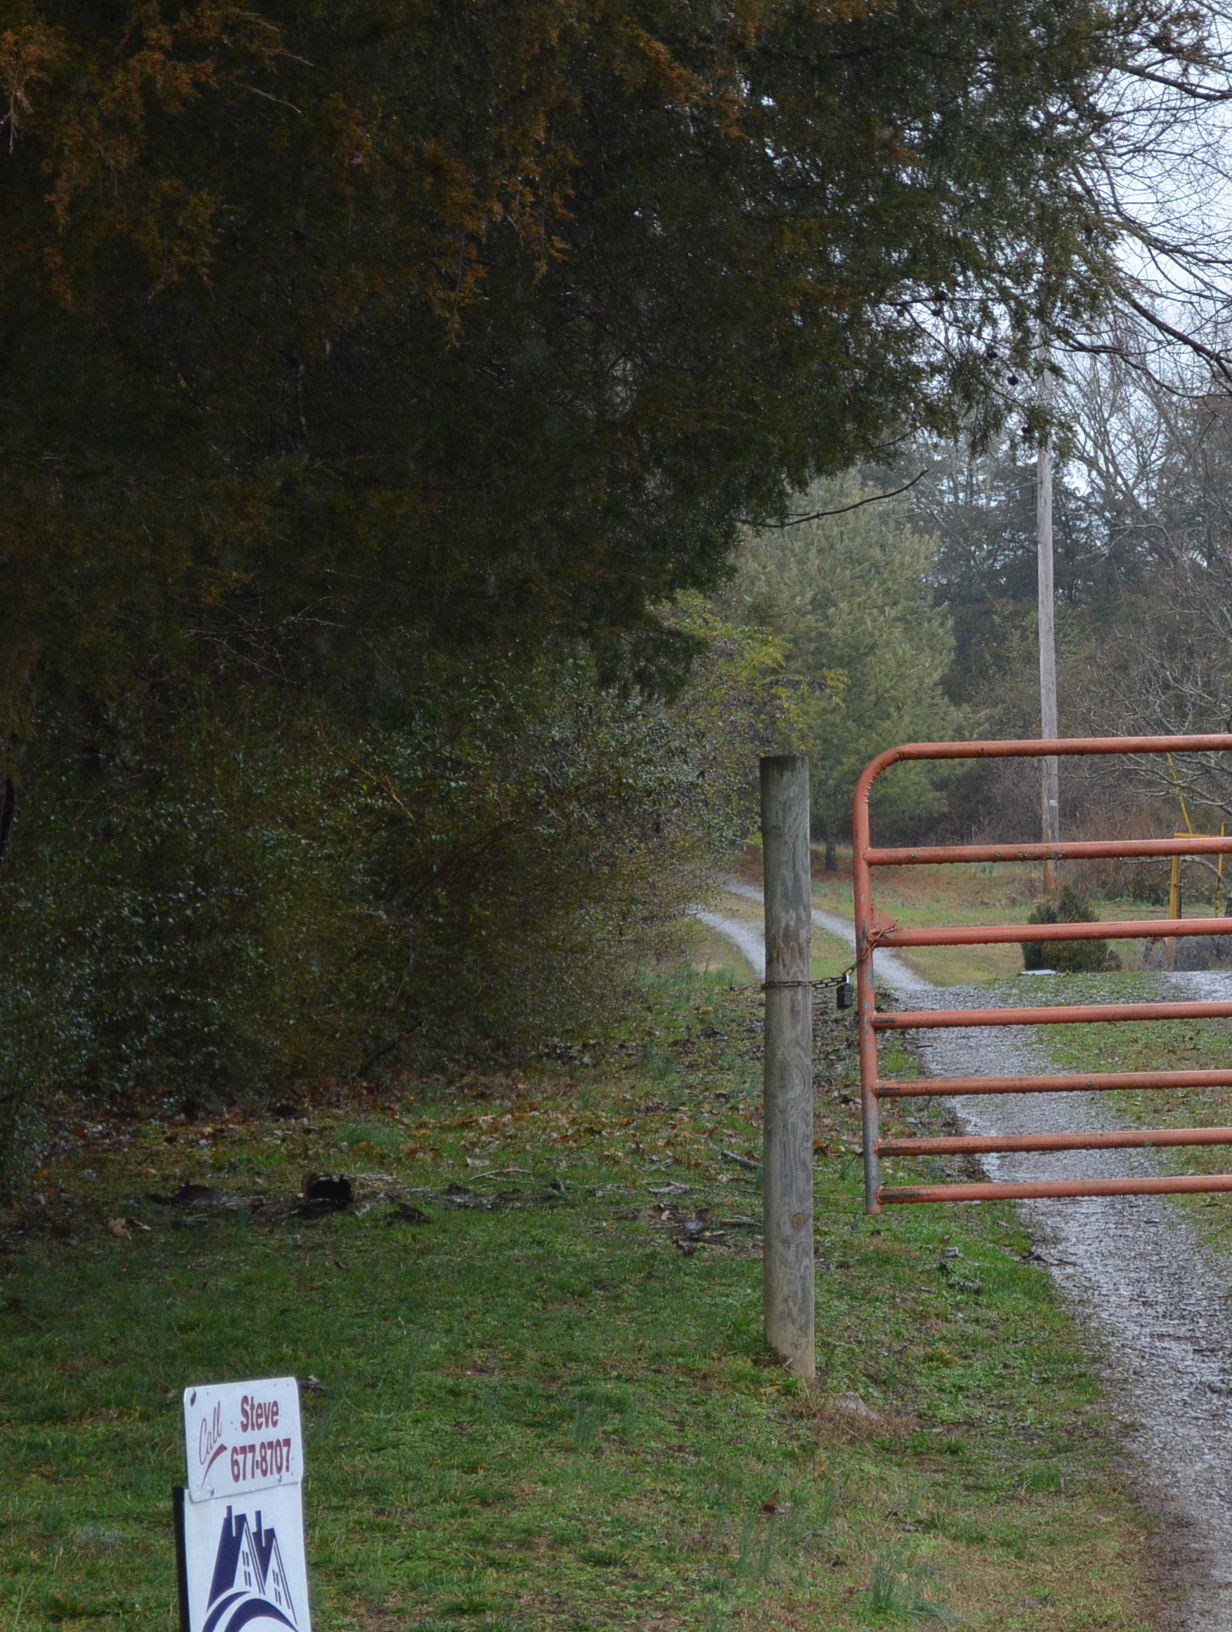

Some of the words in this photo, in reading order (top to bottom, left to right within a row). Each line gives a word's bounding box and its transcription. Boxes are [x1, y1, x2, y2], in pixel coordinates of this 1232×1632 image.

[199, 1401, 223, 1466] Call
[240, 1395, 279, 1433] Steve
[230, 1438, 291, 1483] 677-8707
